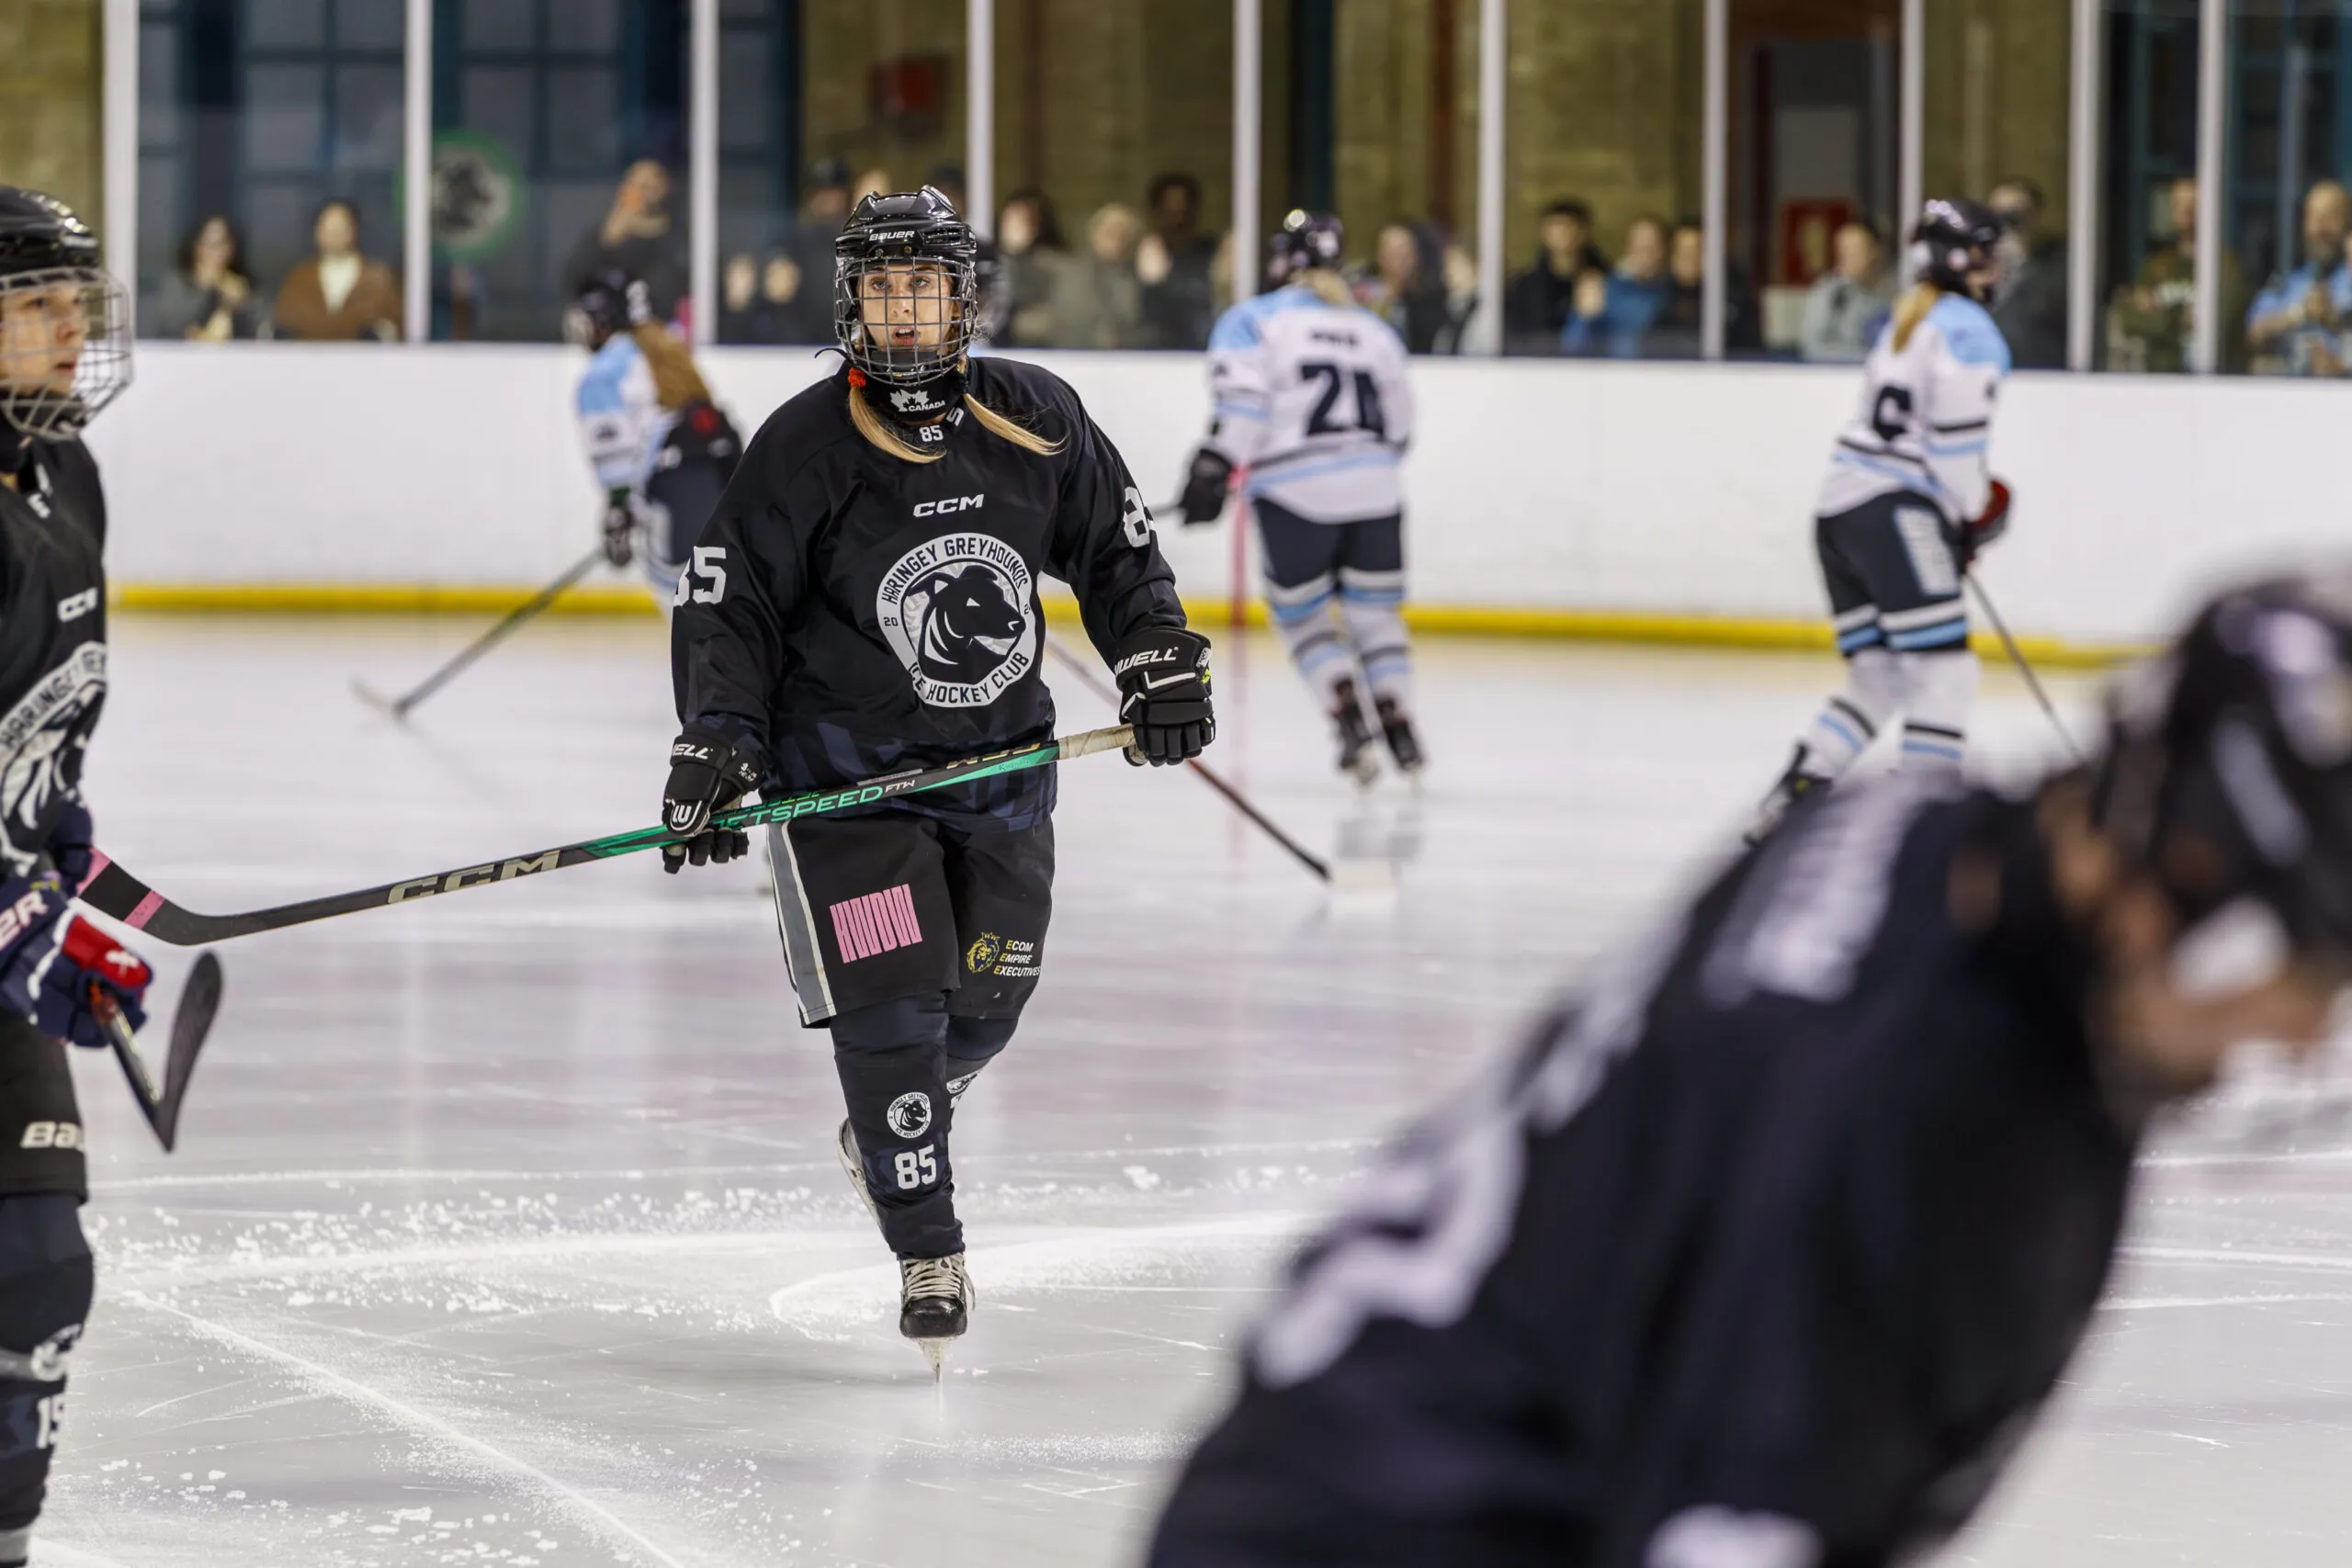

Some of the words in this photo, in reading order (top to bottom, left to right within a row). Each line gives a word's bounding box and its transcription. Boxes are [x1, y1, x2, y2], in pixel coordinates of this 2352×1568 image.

[908, 400, 946, 412] CANADA
[920, 424, 944, 443] 85
[912, 493, 985, 518] CCM
[1124, 486, 1157, 548] 8
[882, 543, 938, 605] HARINGEY
[944, 536, 1028, 590] GREYHOUNDS
[883, 616, 899, 626] 20
[908, 661, 927, 692] ICE
[926, 682, 990, 704] HOCKEY
[990, 651, 1030, 689] CLUB
[885, 779, 916, 794] FTW
[387, 849, 561, 905] CCM
[1005, 939, 1035, 953] ECOM
[999, 953, 1034, 964] EMPIRE
[992, 964, 1042, 977] EXECUTIVES
[894, 1144, 937, 1190] 85
